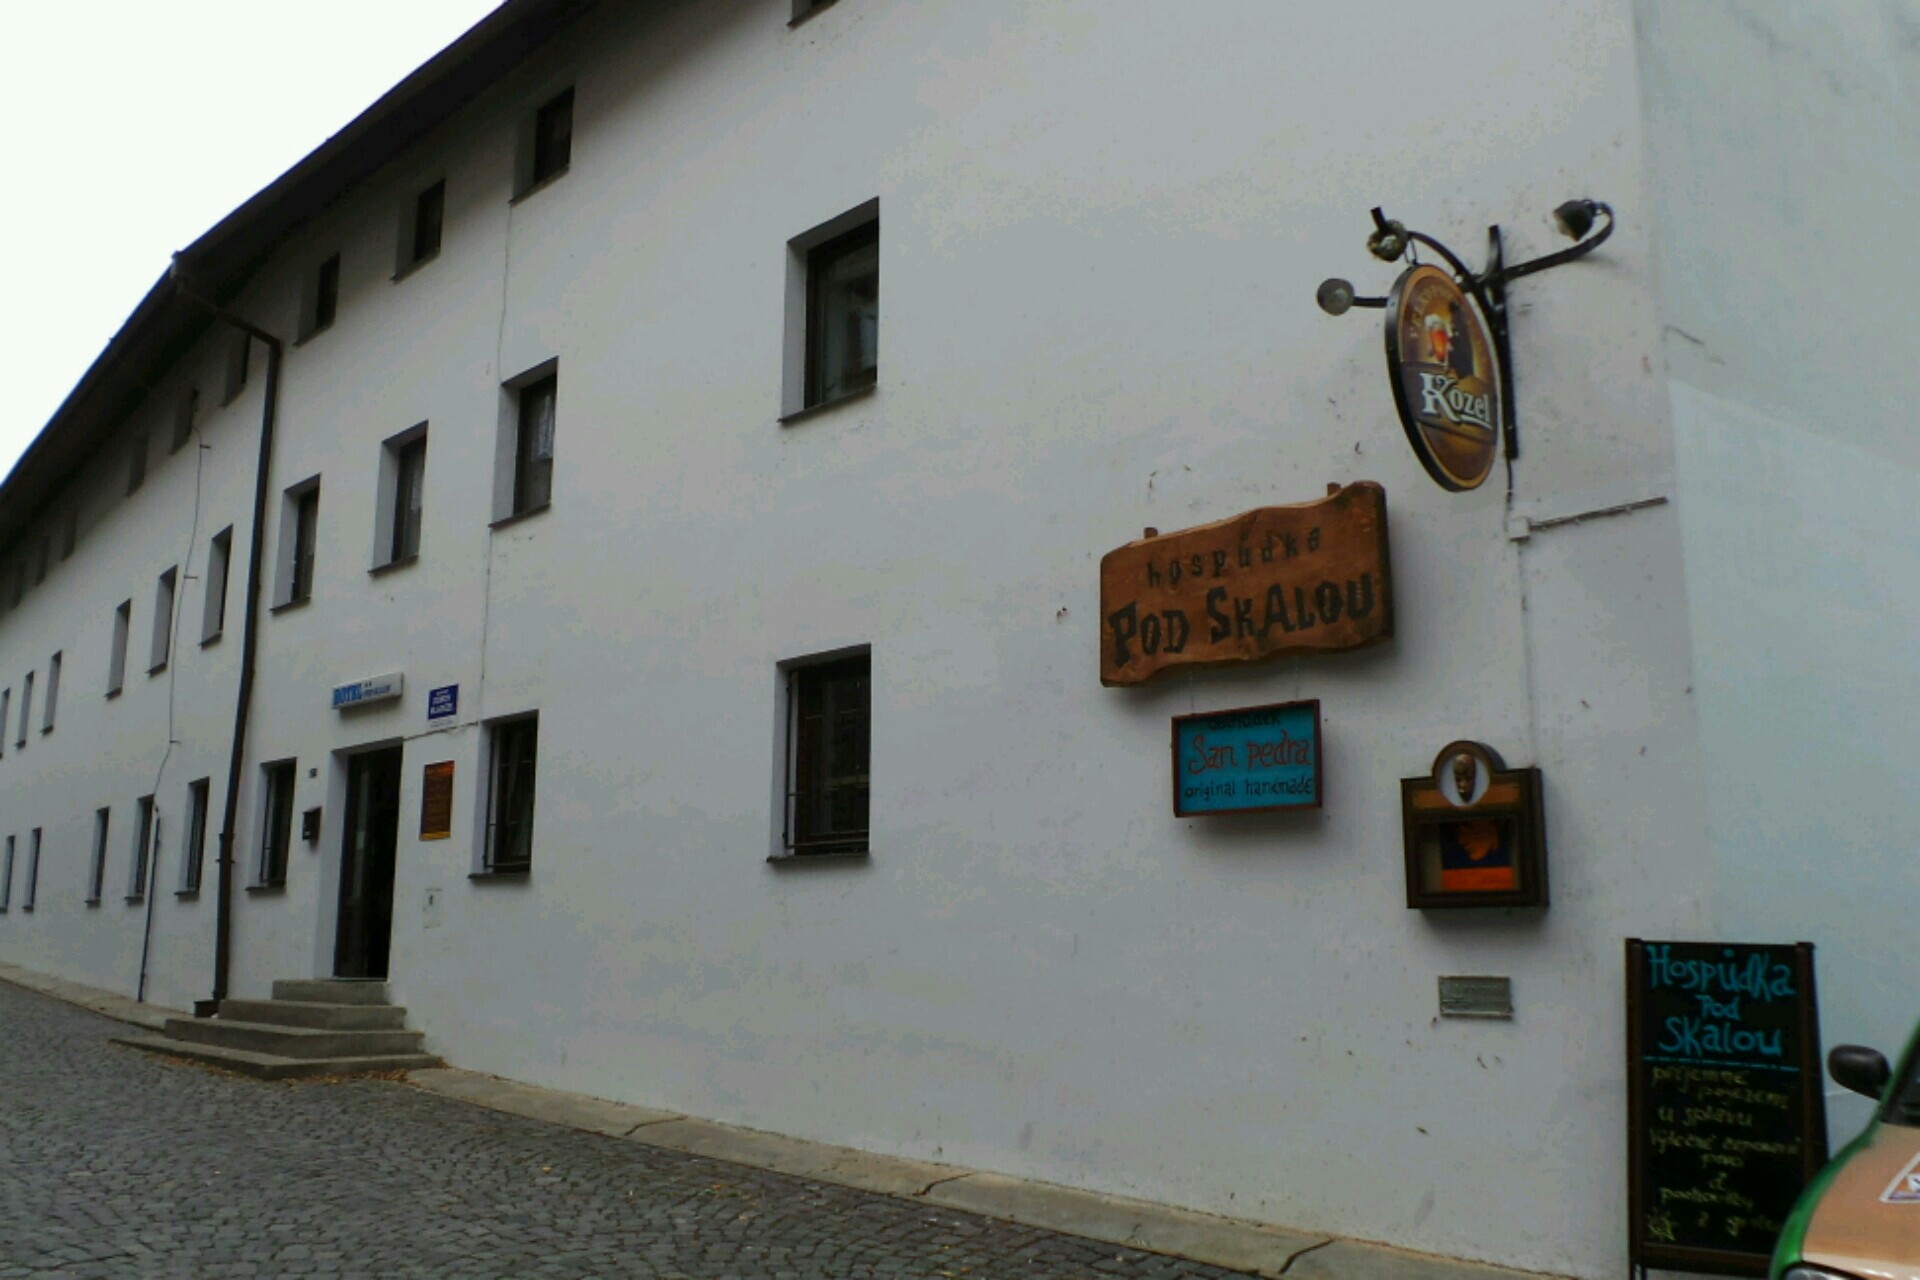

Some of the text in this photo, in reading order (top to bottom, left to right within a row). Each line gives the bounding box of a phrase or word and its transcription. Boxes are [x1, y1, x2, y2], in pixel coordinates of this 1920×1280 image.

[1419, 372, 1492, 429] Kozel
[1188, 735, 1237, 775] San
[1185, 780, 1235, 801] original
[1695, 994, 1741, 1021] Pod
